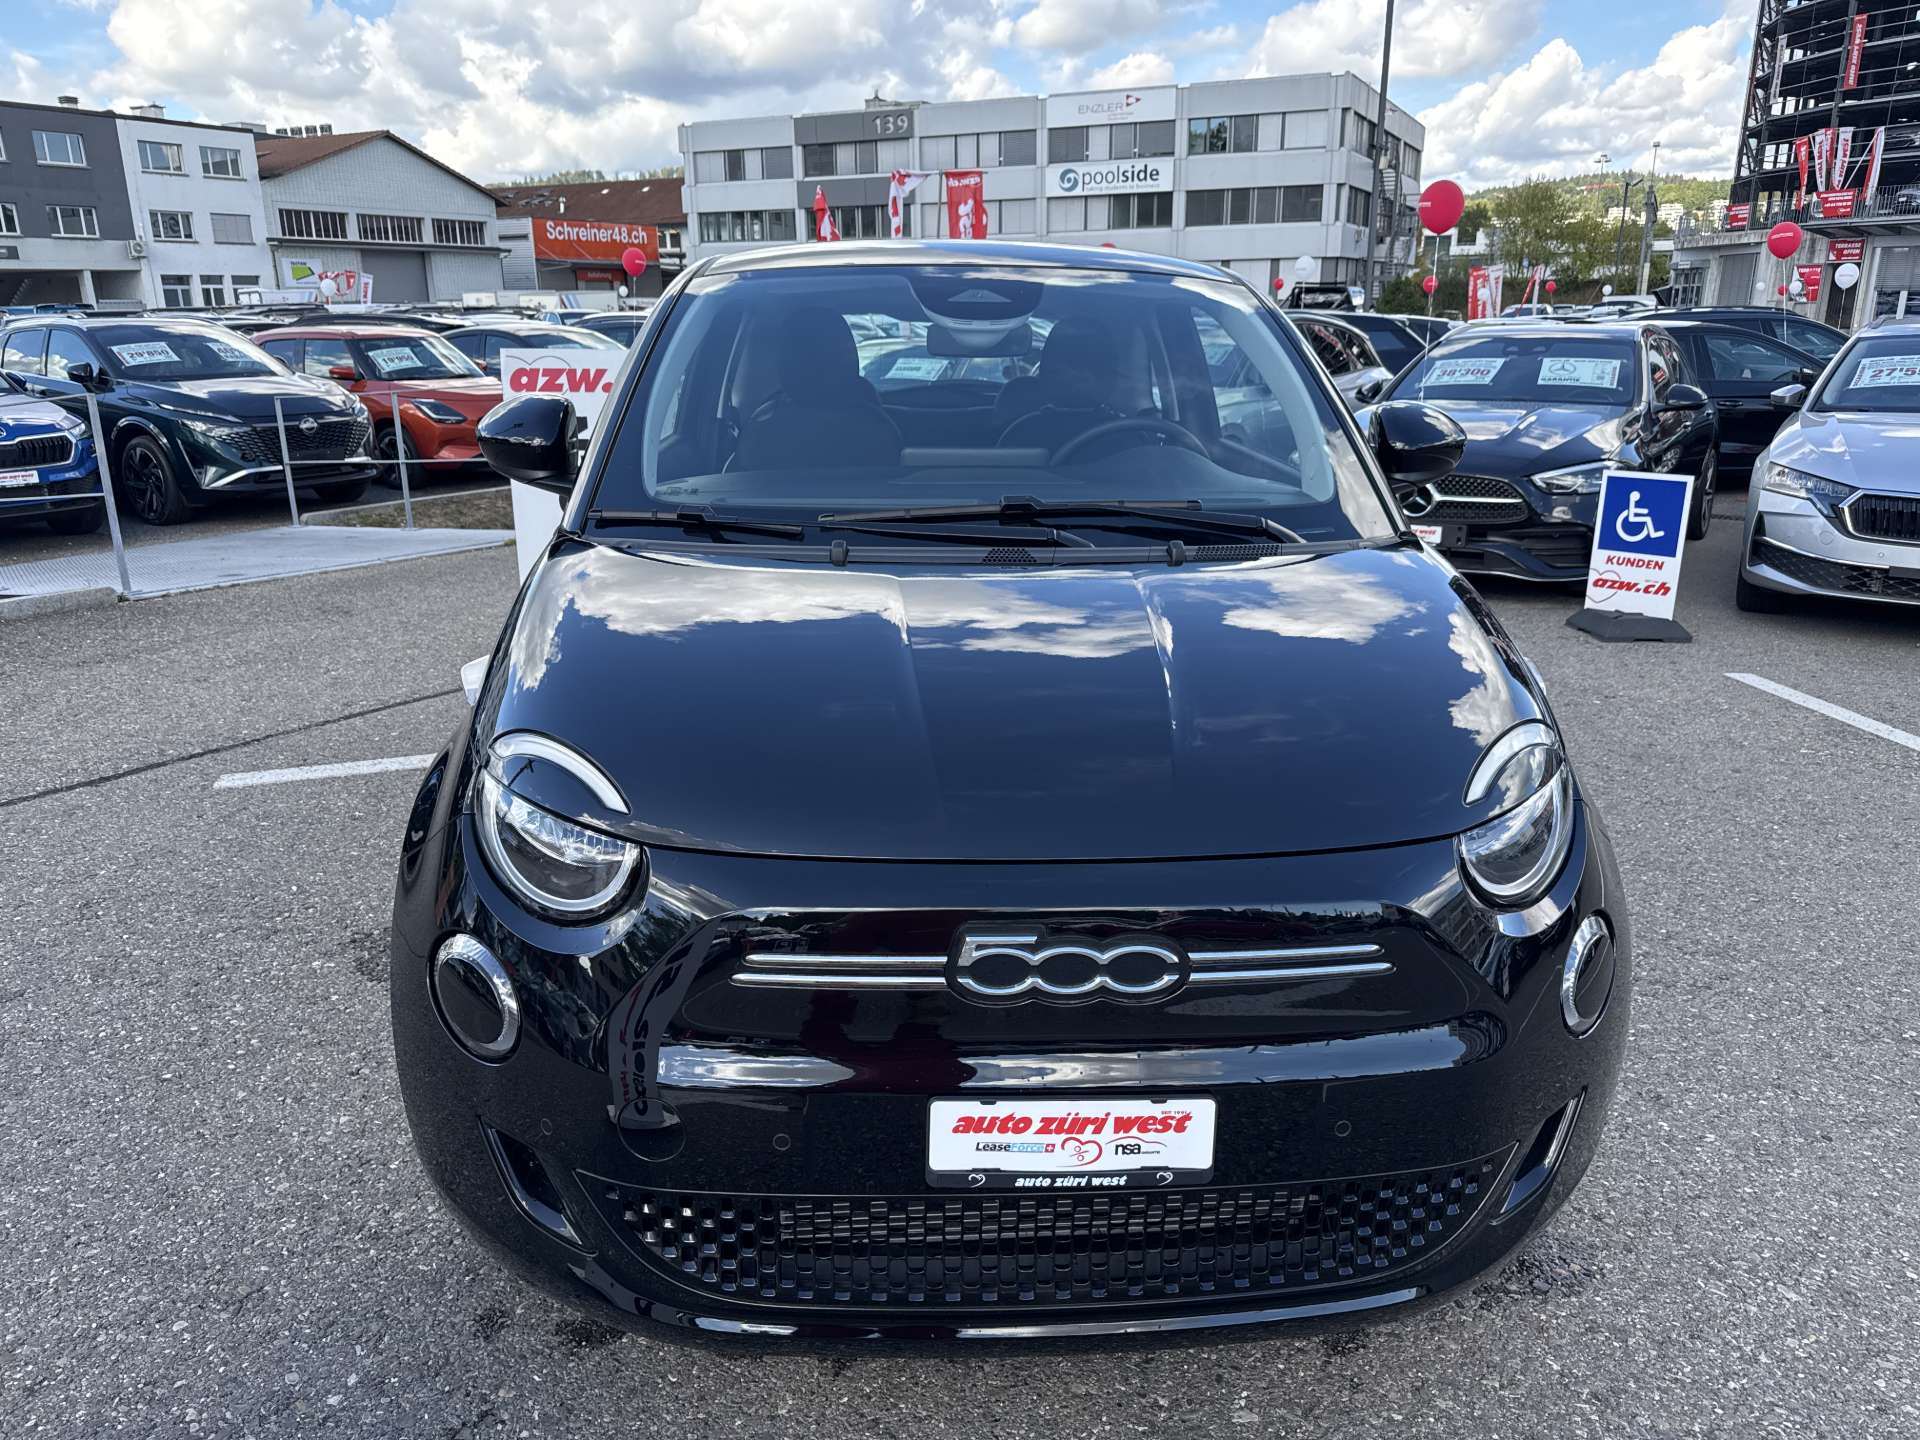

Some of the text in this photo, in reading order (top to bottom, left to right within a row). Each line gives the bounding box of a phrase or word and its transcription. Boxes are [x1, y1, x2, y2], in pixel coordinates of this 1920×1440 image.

[1077, 102, 1124, 115] ENZLER
[873, 115, 909, 135] 139
[1081, 163, 1160, 192] poolside
[545, 220, 648, 245] Schreiner48.ch
[1439, 367, 1491, 377] 38'300
[1870, 367, 1920, 379] 27'5
[1605, 555, 1665, 571] KUNDEN
[1592, 577, 1672, 597] azw.ch
[957, 935, 1180, 995] 500
[951, 1111, 1193, 1135] auto züri west
[975, 1141, 1142, 1156] LeaseForce nsa
[1014, 1174, 1128, 1187] auto züri west
